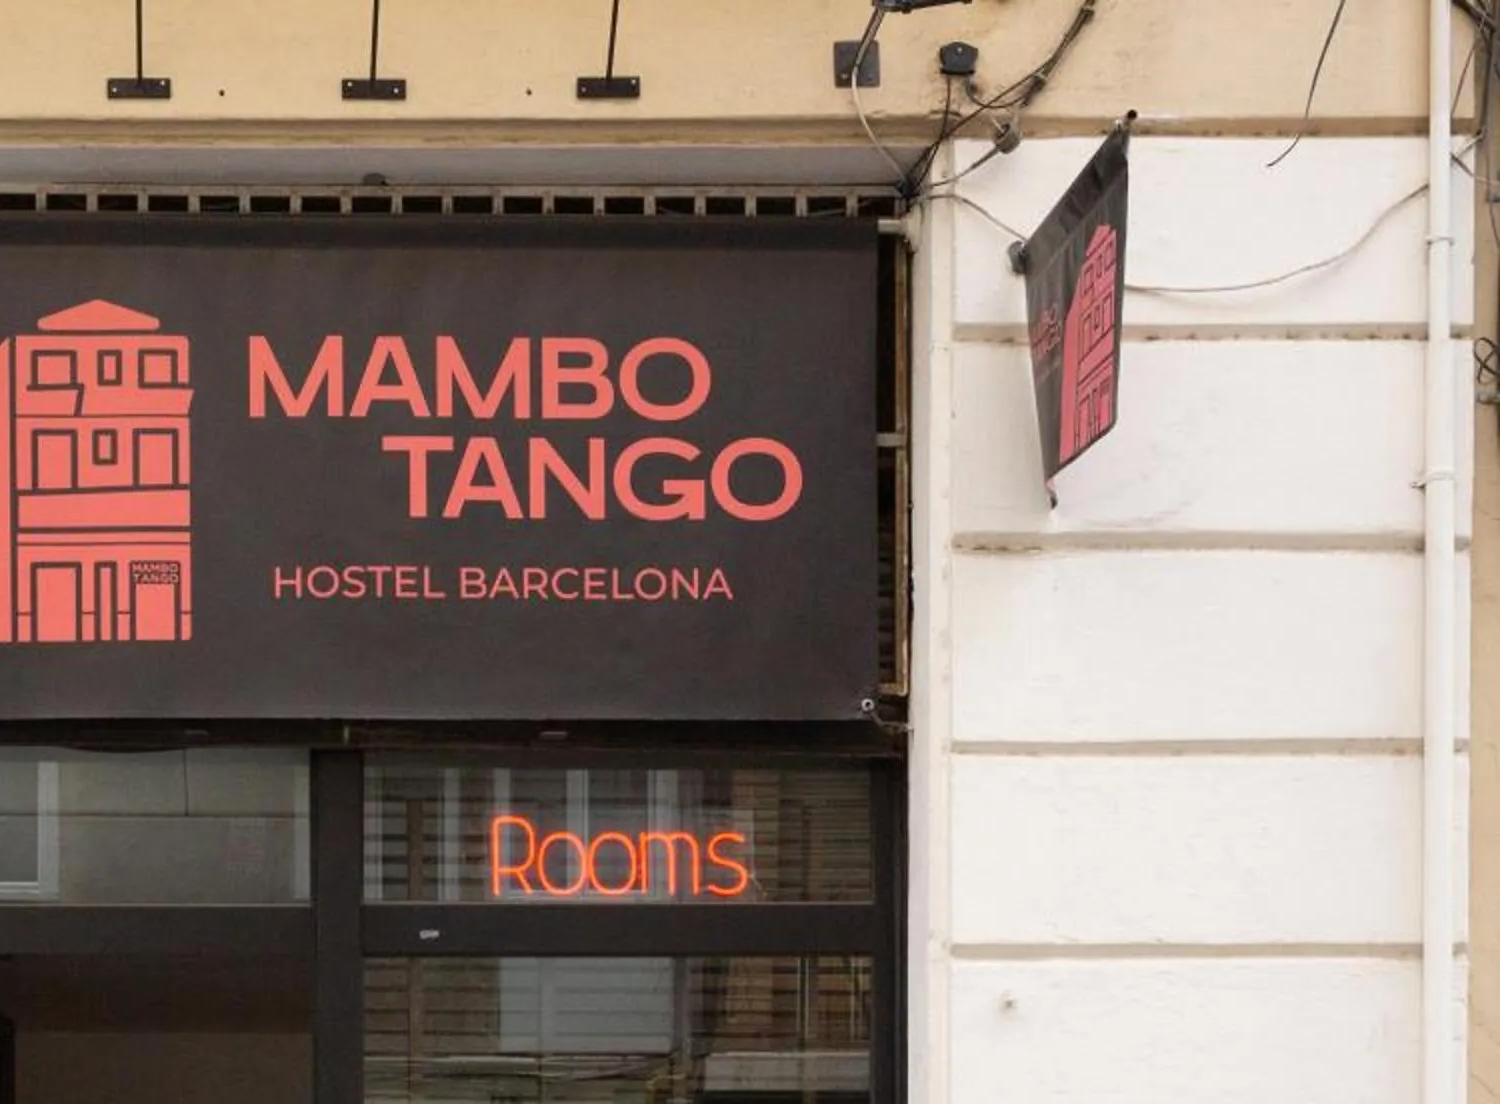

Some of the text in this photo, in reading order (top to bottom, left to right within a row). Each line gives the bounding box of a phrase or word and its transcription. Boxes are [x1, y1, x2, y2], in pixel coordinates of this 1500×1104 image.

[248, 335, 712, 421] MAMBO
[381, 435, 804, 521] TANGO
[274, 564, 734, 600] HOSTEL BARCELONA
[490, 814, 751, 897] Rooms
